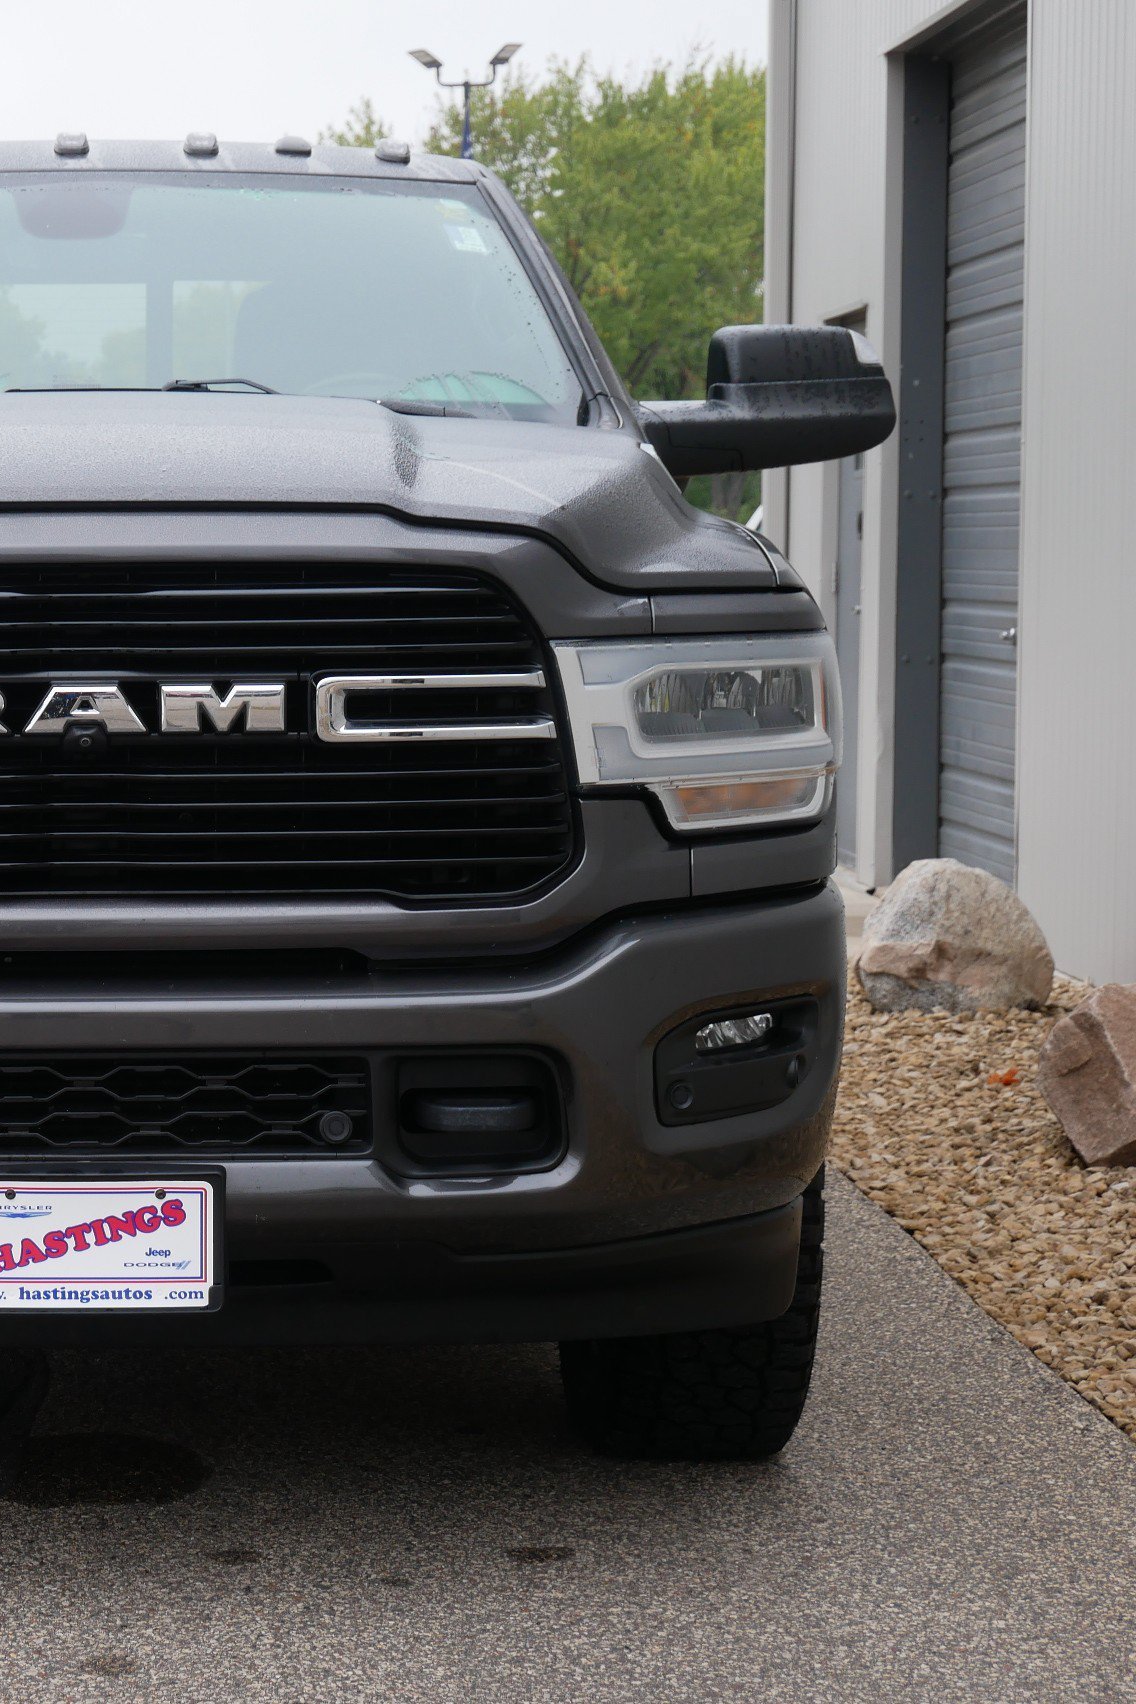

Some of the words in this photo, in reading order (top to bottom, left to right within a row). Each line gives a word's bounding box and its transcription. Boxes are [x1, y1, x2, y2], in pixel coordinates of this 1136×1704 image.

[145, 1247, 171, 1258] Jeep
[18, 1286, 153, 1303] hastingsautos
[164, 1289, 204, 1300] .com
